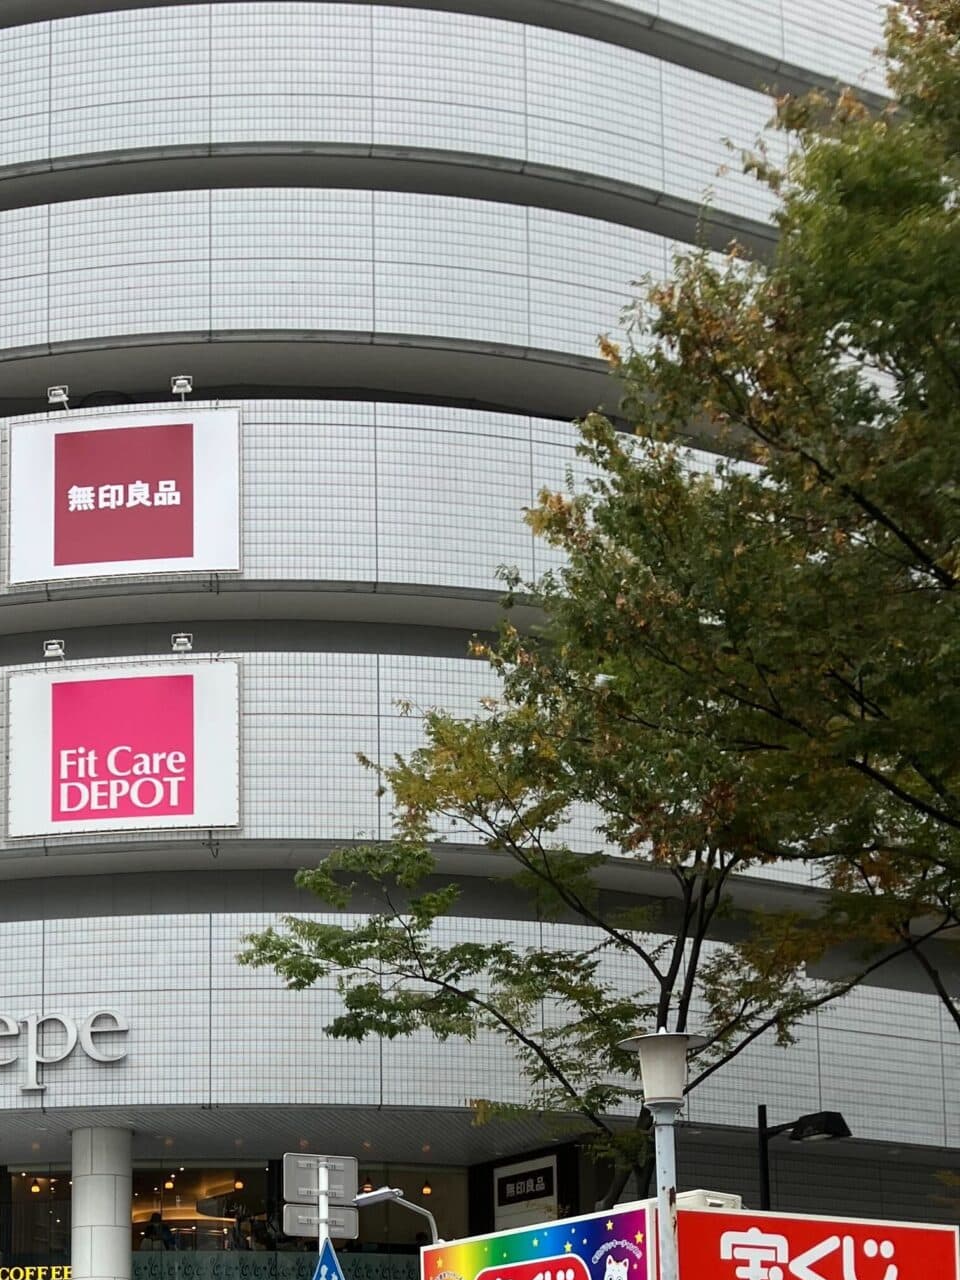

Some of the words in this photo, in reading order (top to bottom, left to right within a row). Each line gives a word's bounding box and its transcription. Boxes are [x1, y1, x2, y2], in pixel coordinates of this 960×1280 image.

[67, 479, 181, 512] 無印良品
[59, 746, 99, 780] Fit
[106, 745, 187, 777] Care
[59, 776, 186, 812] DEPOT
[505, 1175, 546, 1199] 無印良品
